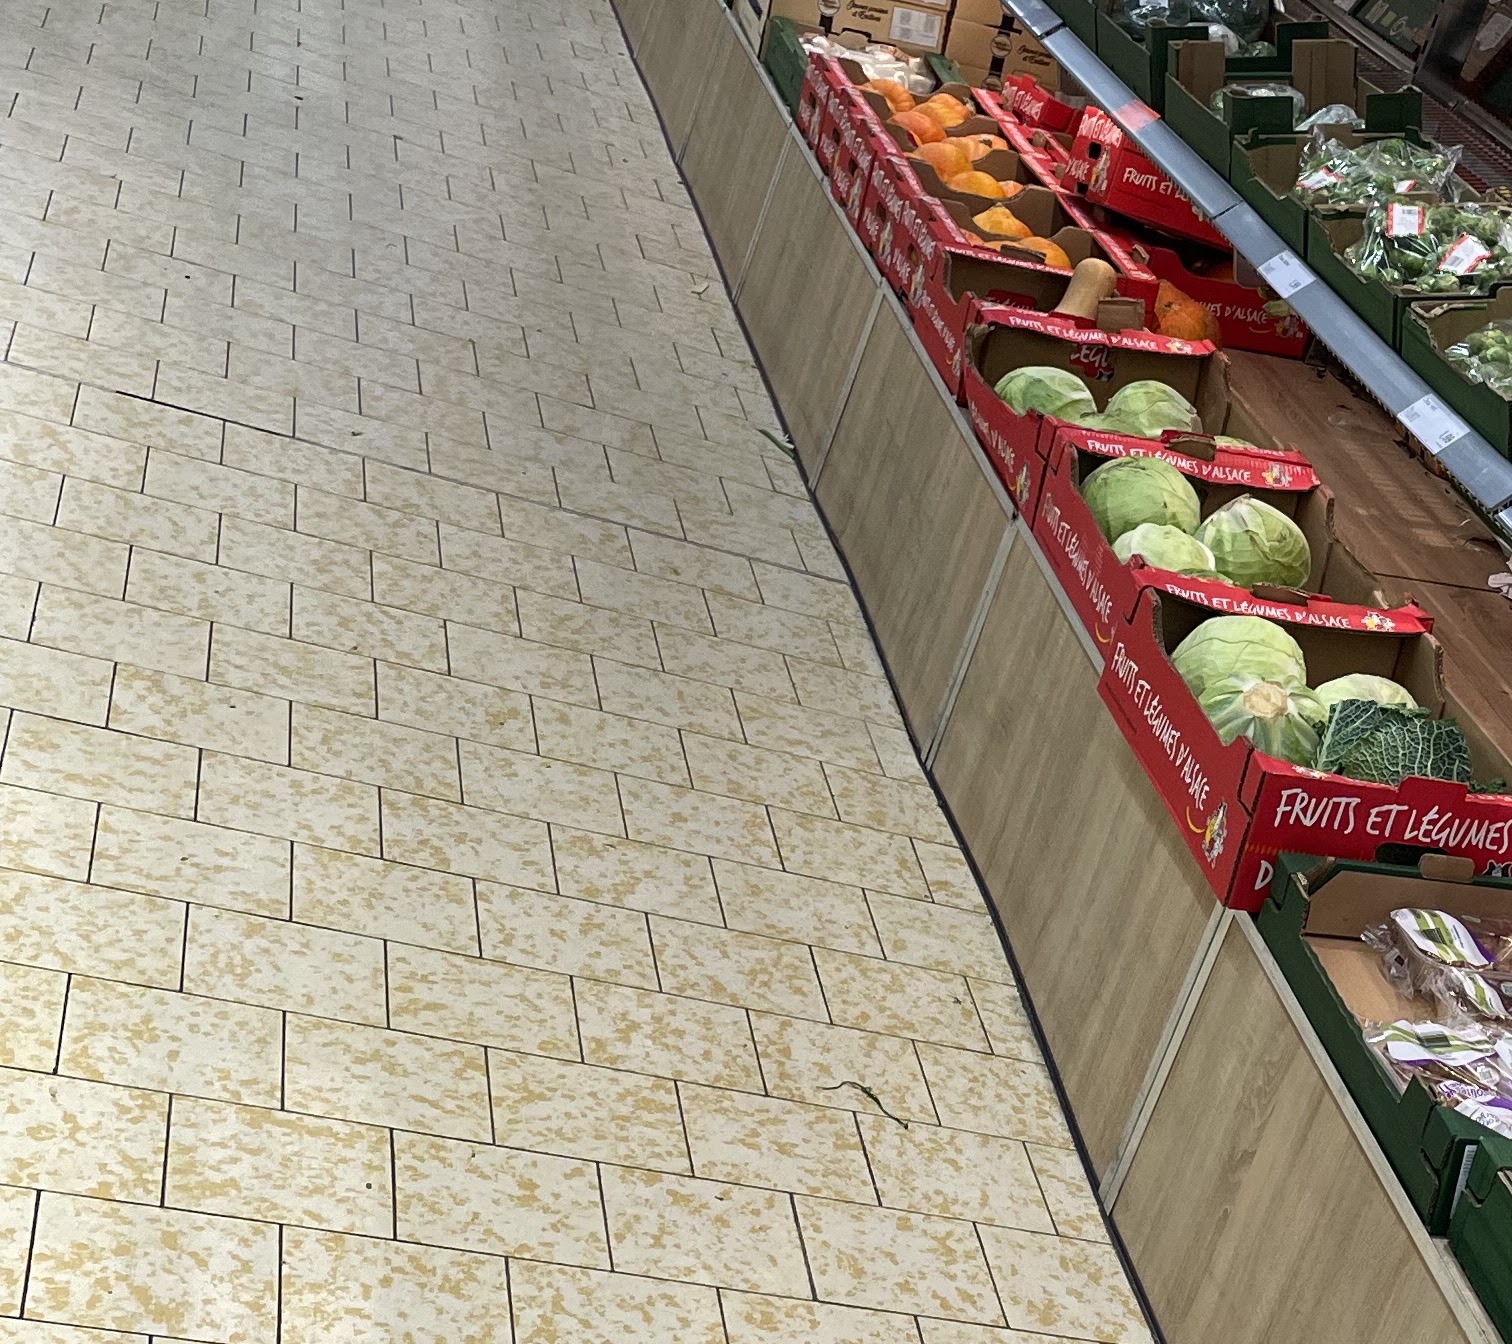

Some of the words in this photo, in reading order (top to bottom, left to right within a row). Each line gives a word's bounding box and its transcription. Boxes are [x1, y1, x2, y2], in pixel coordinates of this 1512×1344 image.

[1122, 167, 1159, 192] FRUITS
[1159, 180, 1175, 196] ET
[1008, 316, 1046, 333] FRUITS
[1109, 330, 1159, 350] D'ALSACE
[1223, 302, 1270, 325] D'ALSACE
[1087, 440, 1125, 457] FRUITS
[1201, 462, 1251, 483] D'ALSACE
[1166, 583, 1210, 605] FRUITS
[1212, 597, 1233, 613] ET
[1233, 598, 1294, 621] LÉGUMES
[1294, 609, 1351, 629] D'ALSACE
[1111, 641, 1139, 692] FRUITS
[1134, 679, 1151, 707] ET
[1143, 694, 1182, 757] LÉGUMES
[1176, 746, 1211, 811] D'ALSACE
[1275, 789, 1357, 835] FRUITS
[1366, 802, 1404, 837] ET
